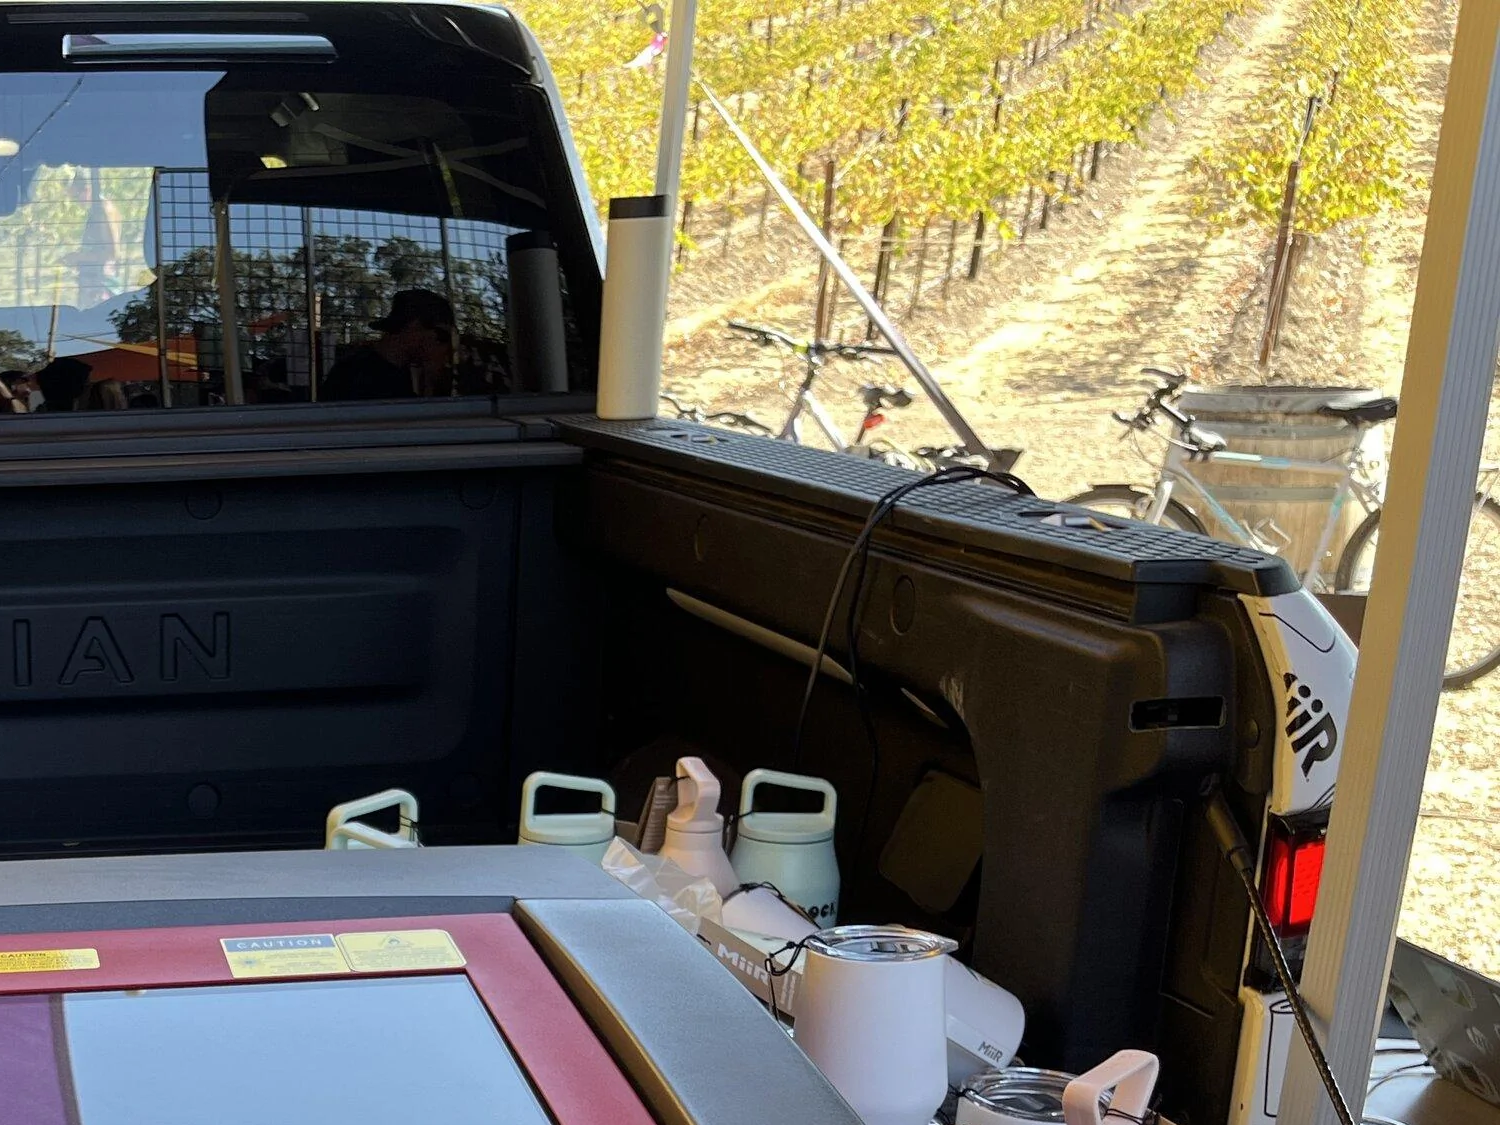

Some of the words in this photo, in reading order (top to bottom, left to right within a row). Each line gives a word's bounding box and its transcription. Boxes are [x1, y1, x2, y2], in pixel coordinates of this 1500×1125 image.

[236, 939, 323, 950] CAUTION
[717, 942, 770, 987] MiiR
[977, 1041, 1004, 1063] MiiR
